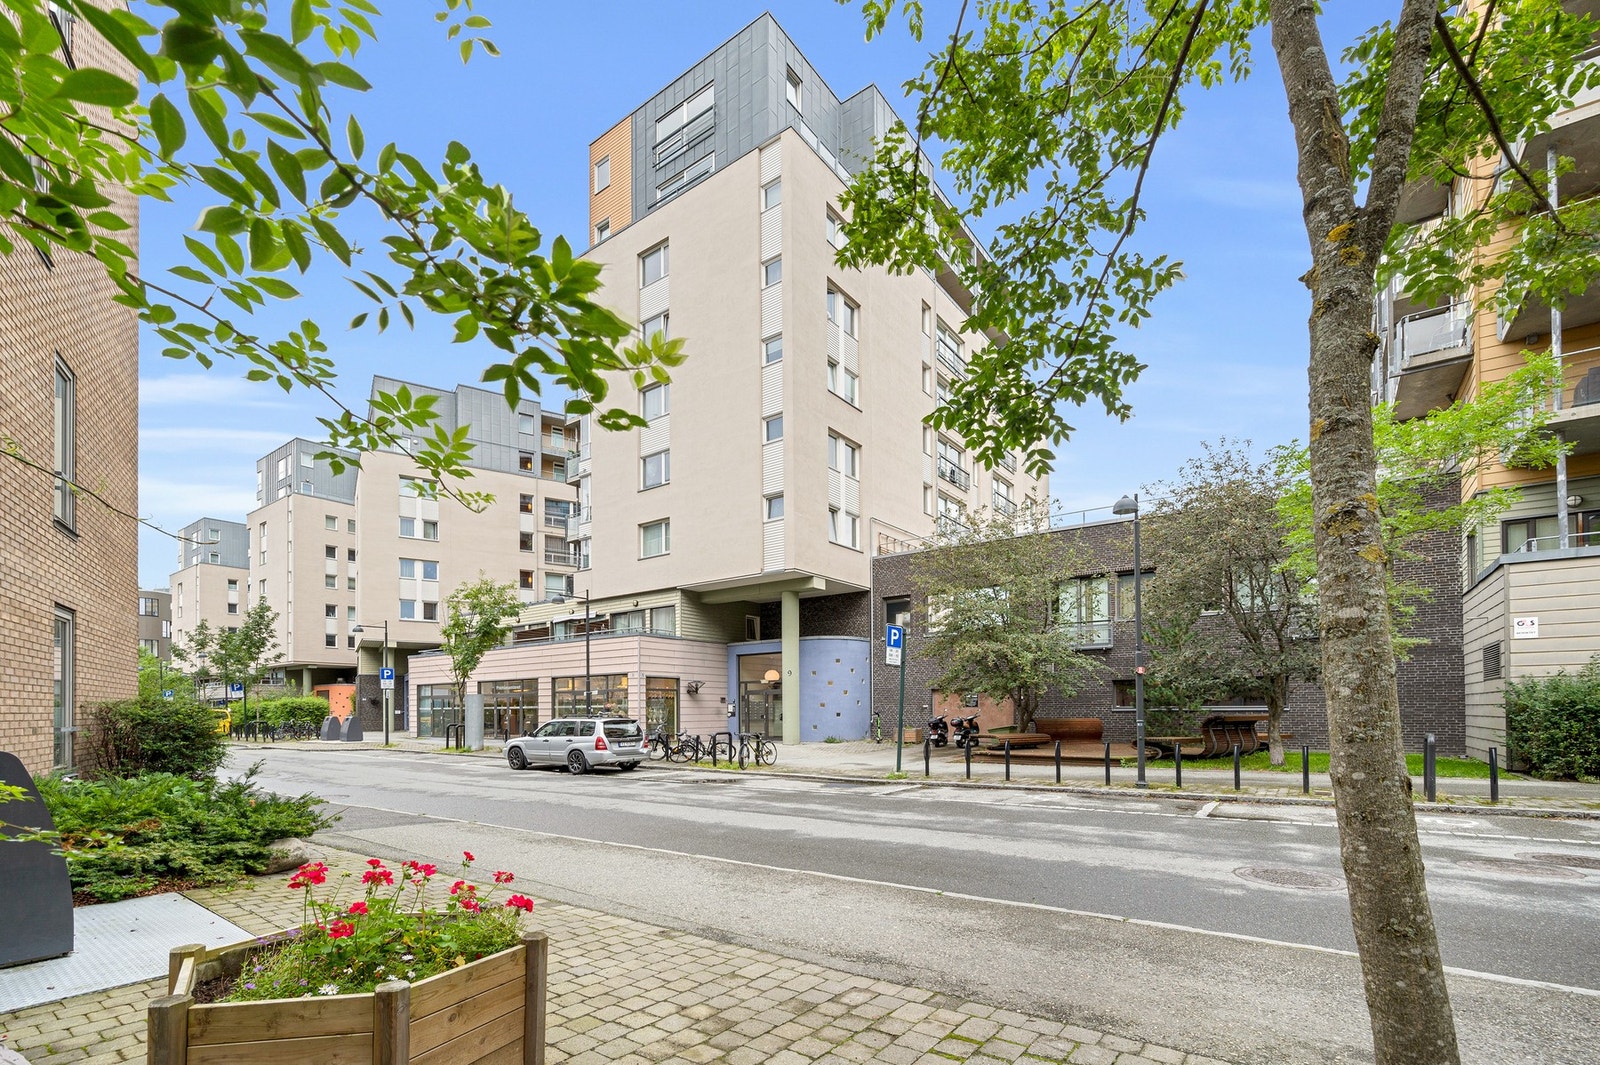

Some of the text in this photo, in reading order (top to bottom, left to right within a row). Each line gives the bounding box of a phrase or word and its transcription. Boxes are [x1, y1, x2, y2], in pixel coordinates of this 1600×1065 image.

[890, 629, 900, 646] P
[383, 669, 392, 679] P
[787, 669, 793, 677] 9
[234, 683, 241, 691] P
